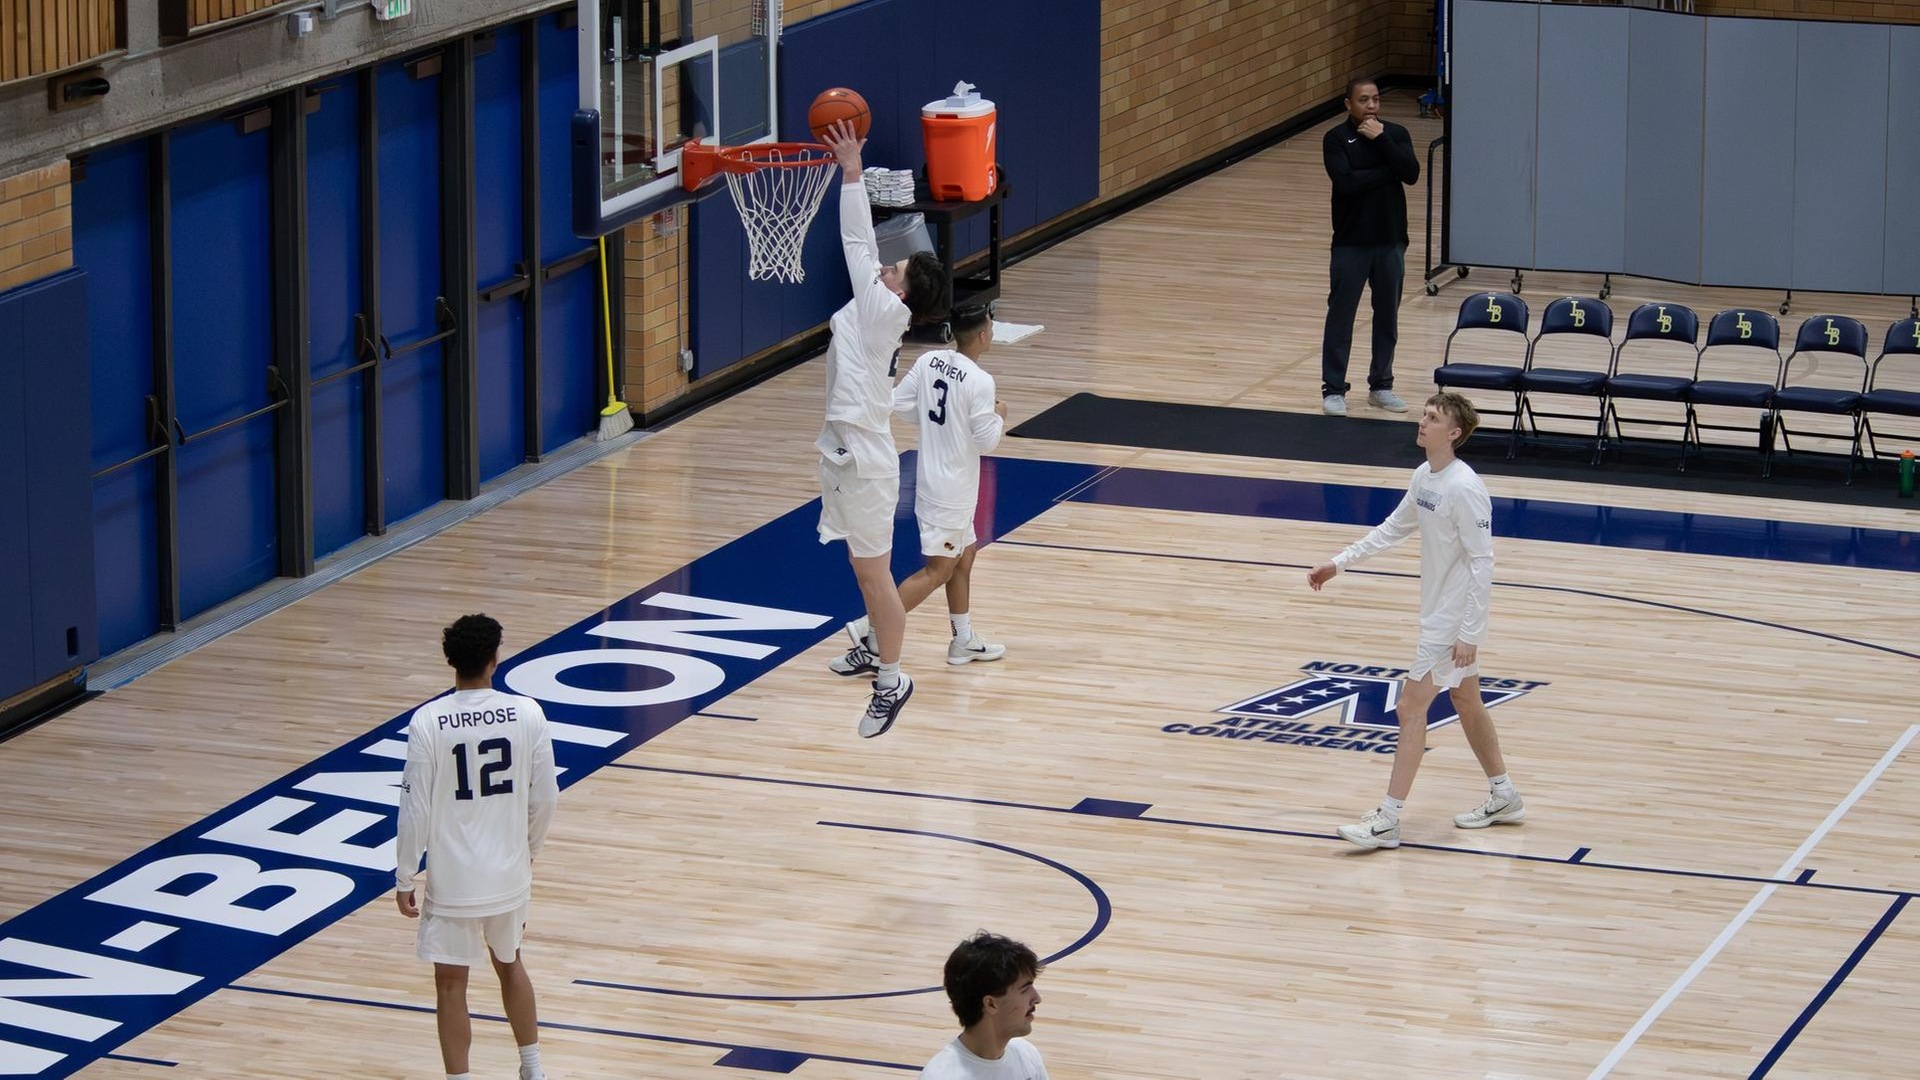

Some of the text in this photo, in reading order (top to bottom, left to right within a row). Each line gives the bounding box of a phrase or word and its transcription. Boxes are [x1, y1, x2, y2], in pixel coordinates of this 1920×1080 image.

[929, 356, 967, 383] DRIVEN
[928, 379, 949, 426] 3
[1298, 660, 1552, 690] NORTEST
[438, 707, 517, 731] PURPOSE
[1161, 723, 1433, 757] CONFERENC
[452, 737, 514, 801] 12
